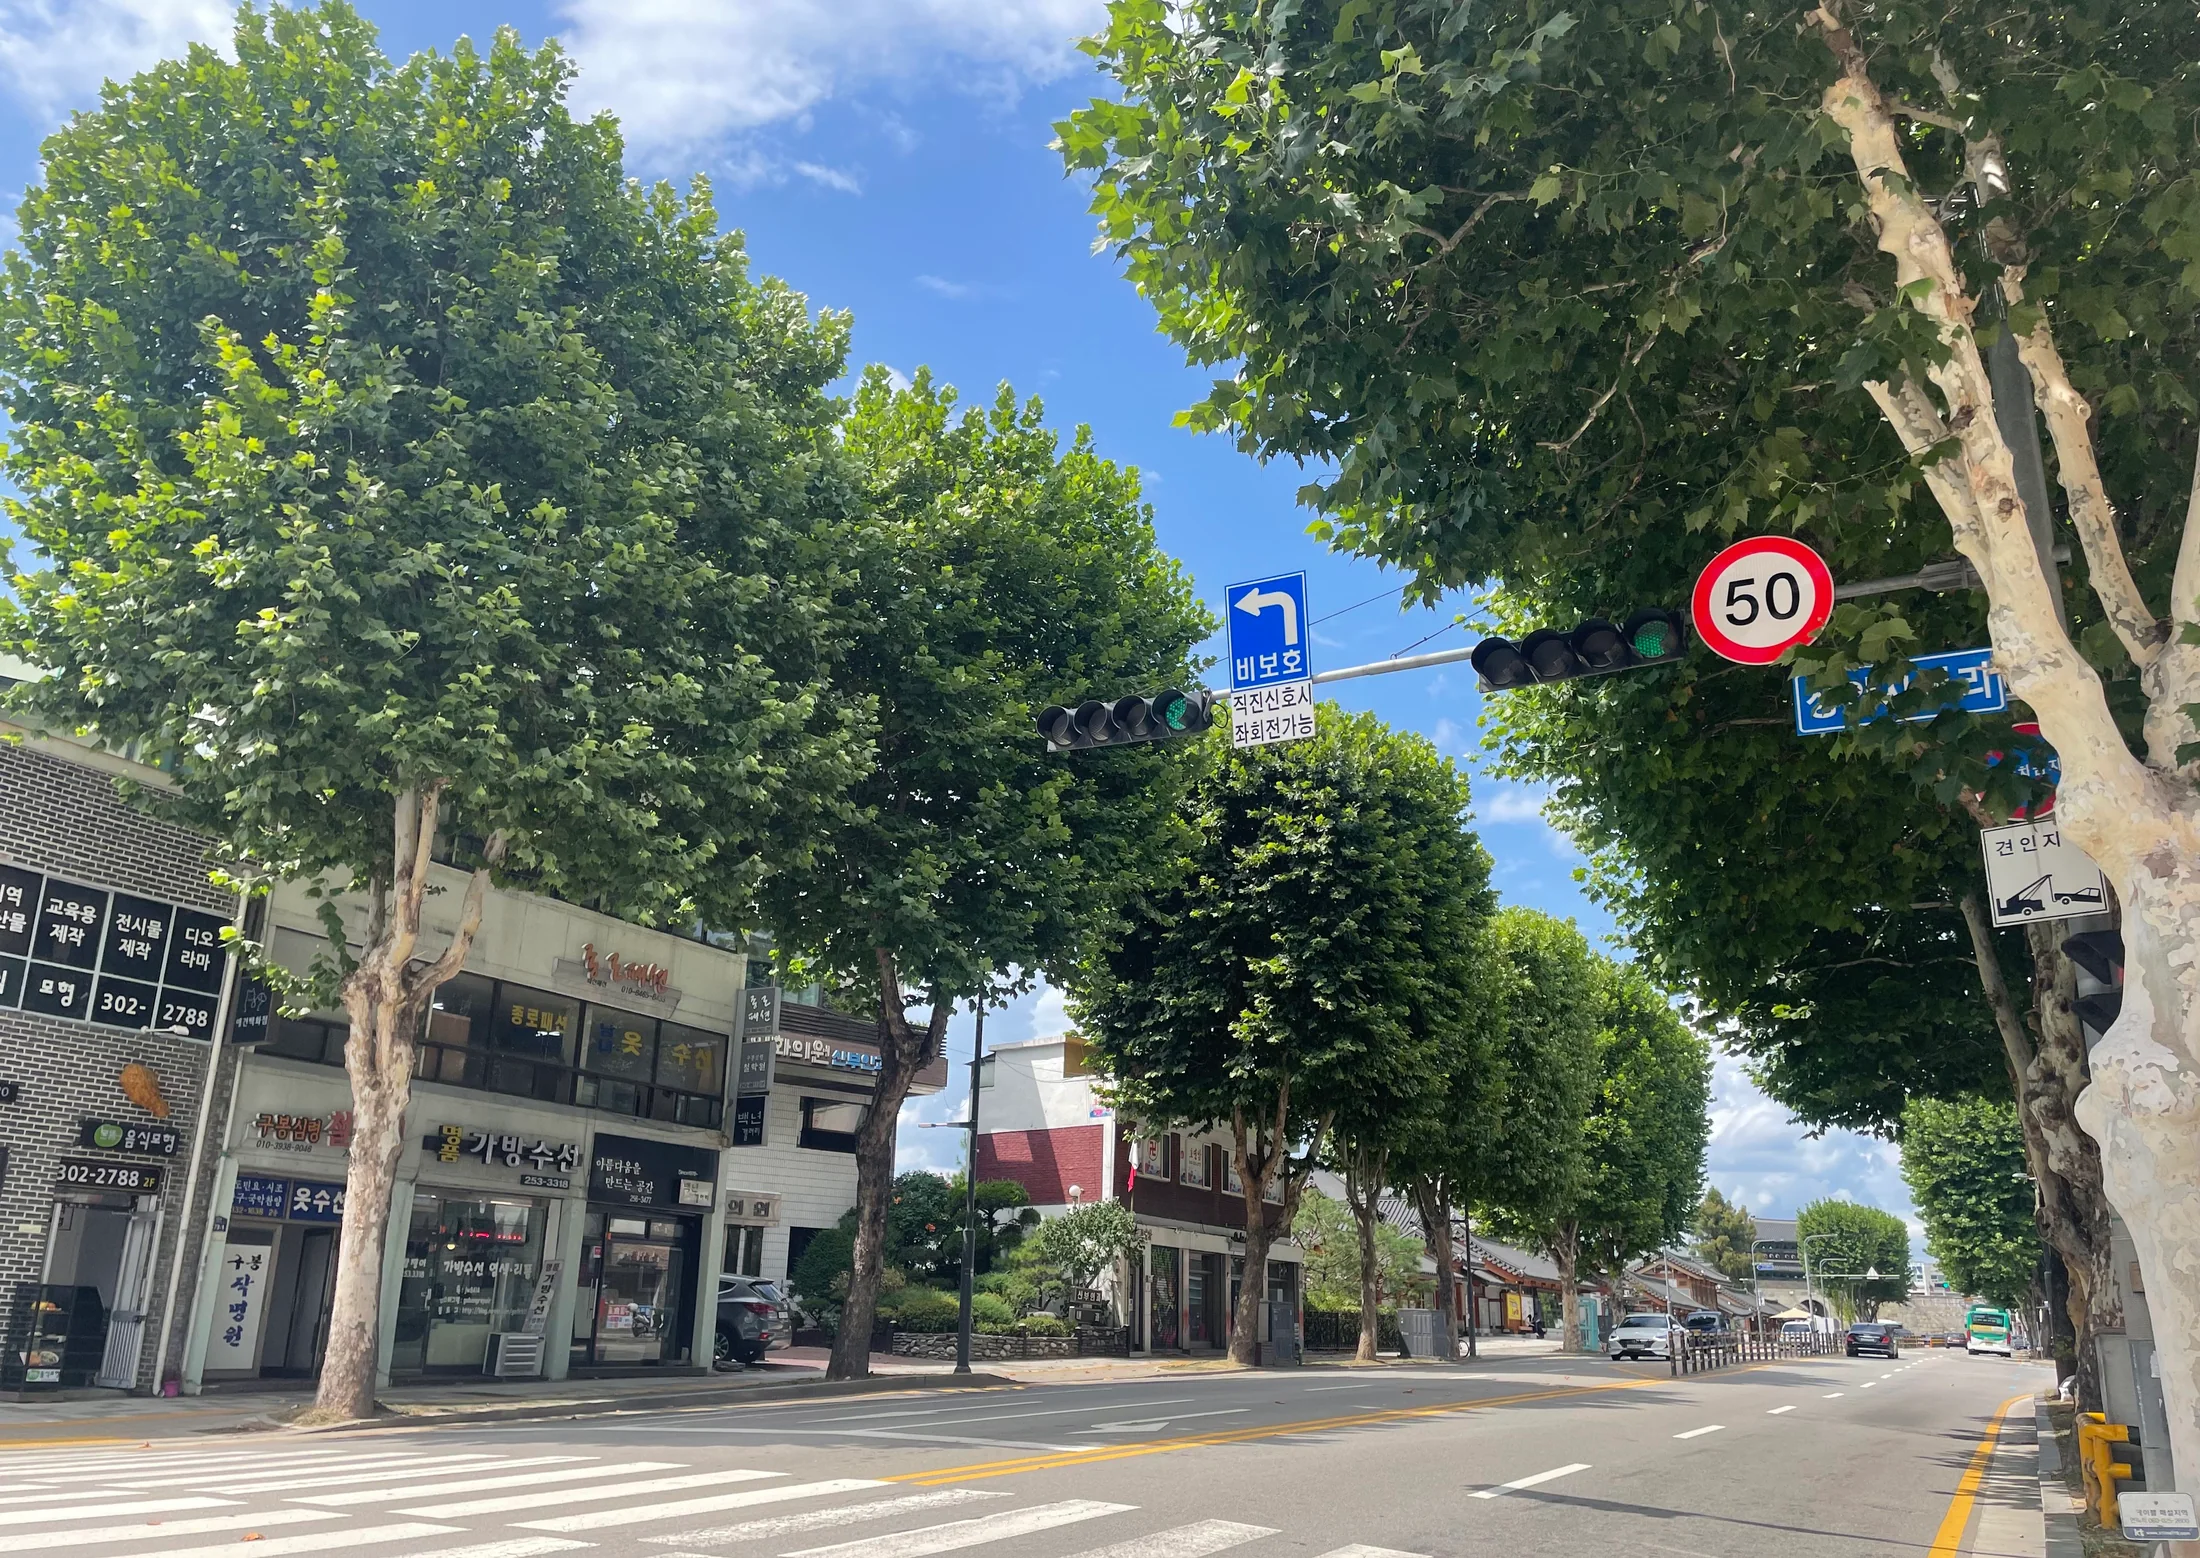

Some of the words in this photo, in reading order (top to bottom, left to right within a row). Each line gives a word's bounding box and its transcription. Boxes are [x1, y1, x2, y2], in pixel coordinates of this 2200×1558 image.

[1725, 571, 1801, 627] 50
[1236, 648, 1303, 682] 비보호
[1233, 682, 1313, 717] 직진신호시
[1235, 713, 1314, 745] 좌회전가능
[1995, 831, 2061, 857] 견인지
[0, 884, 23, 907] 역
[45, 897, 98, 925] 교육용
[49, 922, 86, 948] 제작
[115, 912, 164, 940] 전시물
[184, 927, 215, 948] 디오
[118, 937, 152, 961] 제작
[180, 949, 212, 972] 라마
[39, 978, 76, 1008] 모형
[162, 1003, 209, 1028] 2788
[510, 1003, 570, 1035] 종로패션
[621, 1031, 643, 1058] 옷
[751, 1034, 831, 1065] 화의원
[737, 1110, 762, 1125] 백년
[124, 1129, 176, 1154] 음식모형
[438, 1124, 463, 1164] 명품
[469, 1131, 581, 1174] 가방수선
[56, 1164, 140, 1187] 302-2788
[143, 1176, 156, 1189] 2F
[596, 1156, 642, 1176] 아름다움을
[523, 1175, 569, 1189] 253-3318
[605, 1175, 633, 1191] 만드는
[636, 1180, 654, 1195] 공간
[227, 1253, 263, 1271] 구봉
[443, 1259, 485, 1278] 가방수선
[222, 1273, 255, 1348] 작명원
[2133, 1528, 2145, 1537] kt
